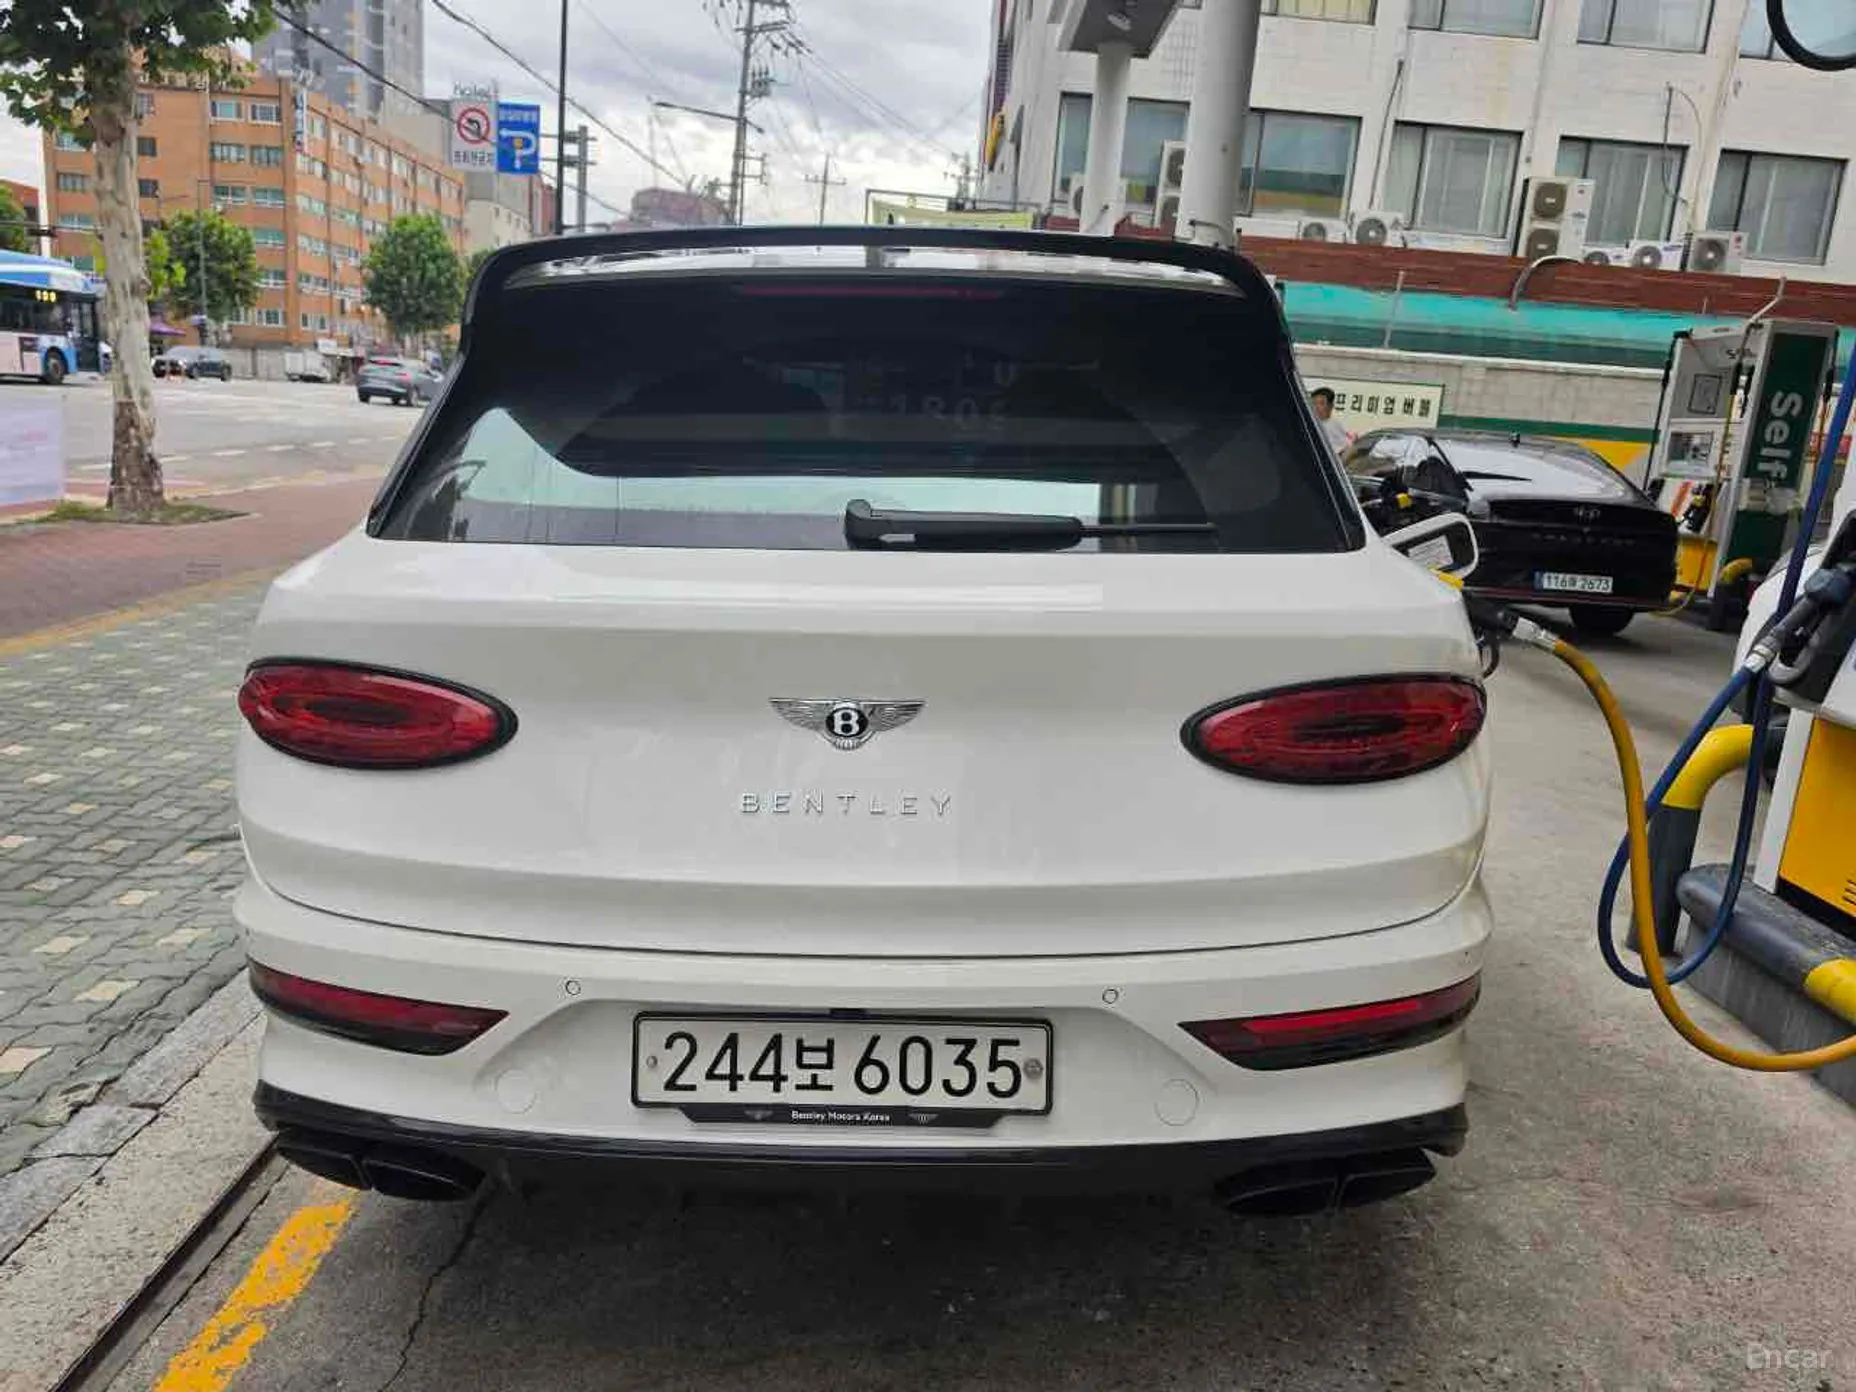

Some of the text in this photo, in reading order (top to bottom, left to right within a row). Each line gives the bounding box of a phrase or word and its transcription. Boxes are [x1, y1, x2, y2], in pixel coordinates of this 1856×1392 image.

[1334, 393, 1395, 415] 프리미엄
[1757, 391, 1803, 481] Self
[833, 707, 860, 735] B
[741, 791, 952, 816] BENTLEY
[663, 1031, 1022, 1099] 244보 6035
[791, 1110, 890, 1122] Bentley Motors Korea
